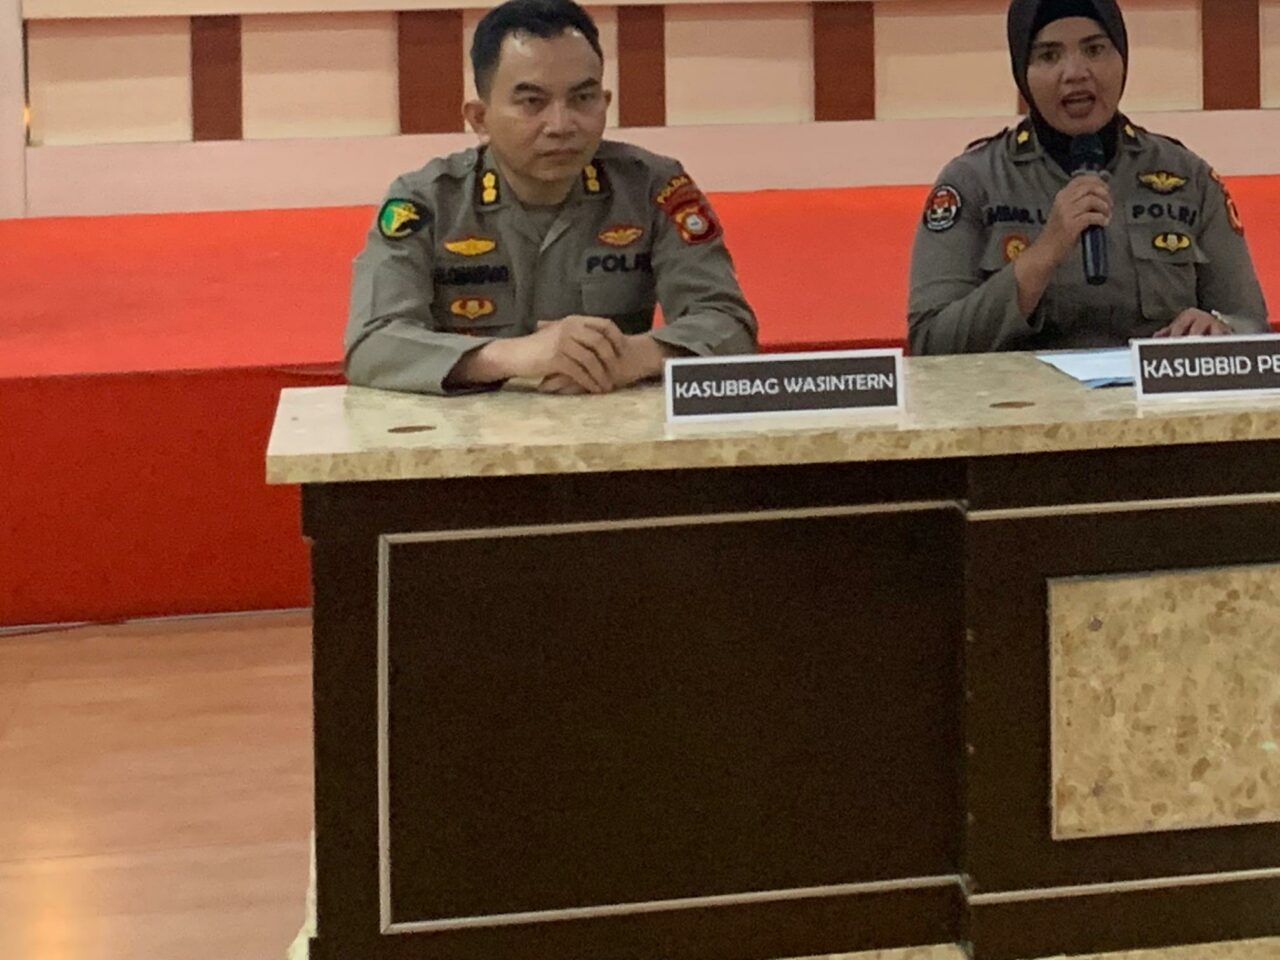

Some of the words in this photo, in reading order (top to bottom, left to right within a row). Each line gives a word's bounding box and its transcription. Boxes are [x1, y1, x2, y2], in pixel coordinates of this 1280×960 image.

[1131, 203, 1198, 228] POLRI
[586, 253, 653, 274] POLR
[1142, 355, 1252, 379] KASUBBID
[675, 378, 780, 398] KASUBBAG
[783, 372, 895, 394] WASINTERN
